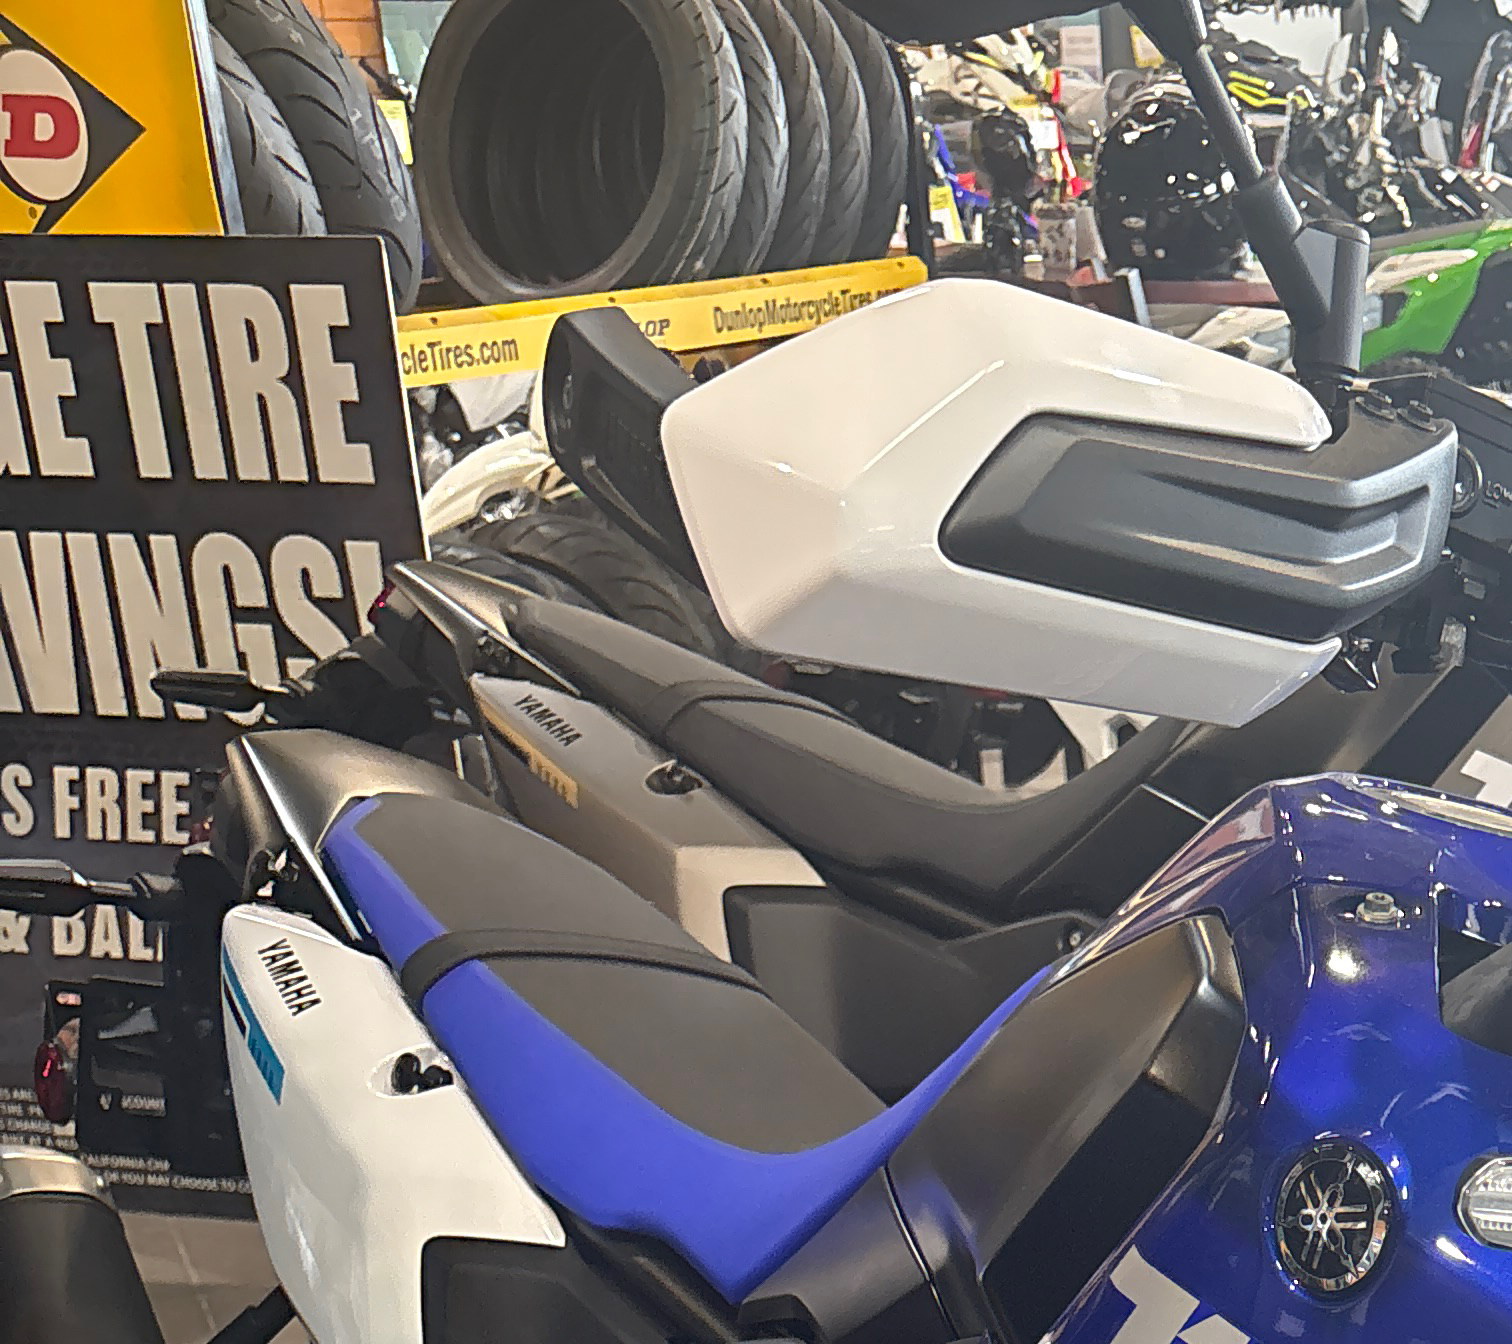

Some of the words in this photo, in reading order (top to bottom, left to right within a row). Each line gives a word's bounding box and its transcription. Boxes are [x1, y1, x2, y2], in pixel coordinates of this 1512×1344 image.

[2, 94, 80, 159] D
[87, 282, 376, 485] TIRE
[514, 694, 582, 746] YAMAHA
[52, 765, 190, 845] FREE
[52, 903, 163, 962] BAL
[257, 937, 322, 1016] YAMAHA
